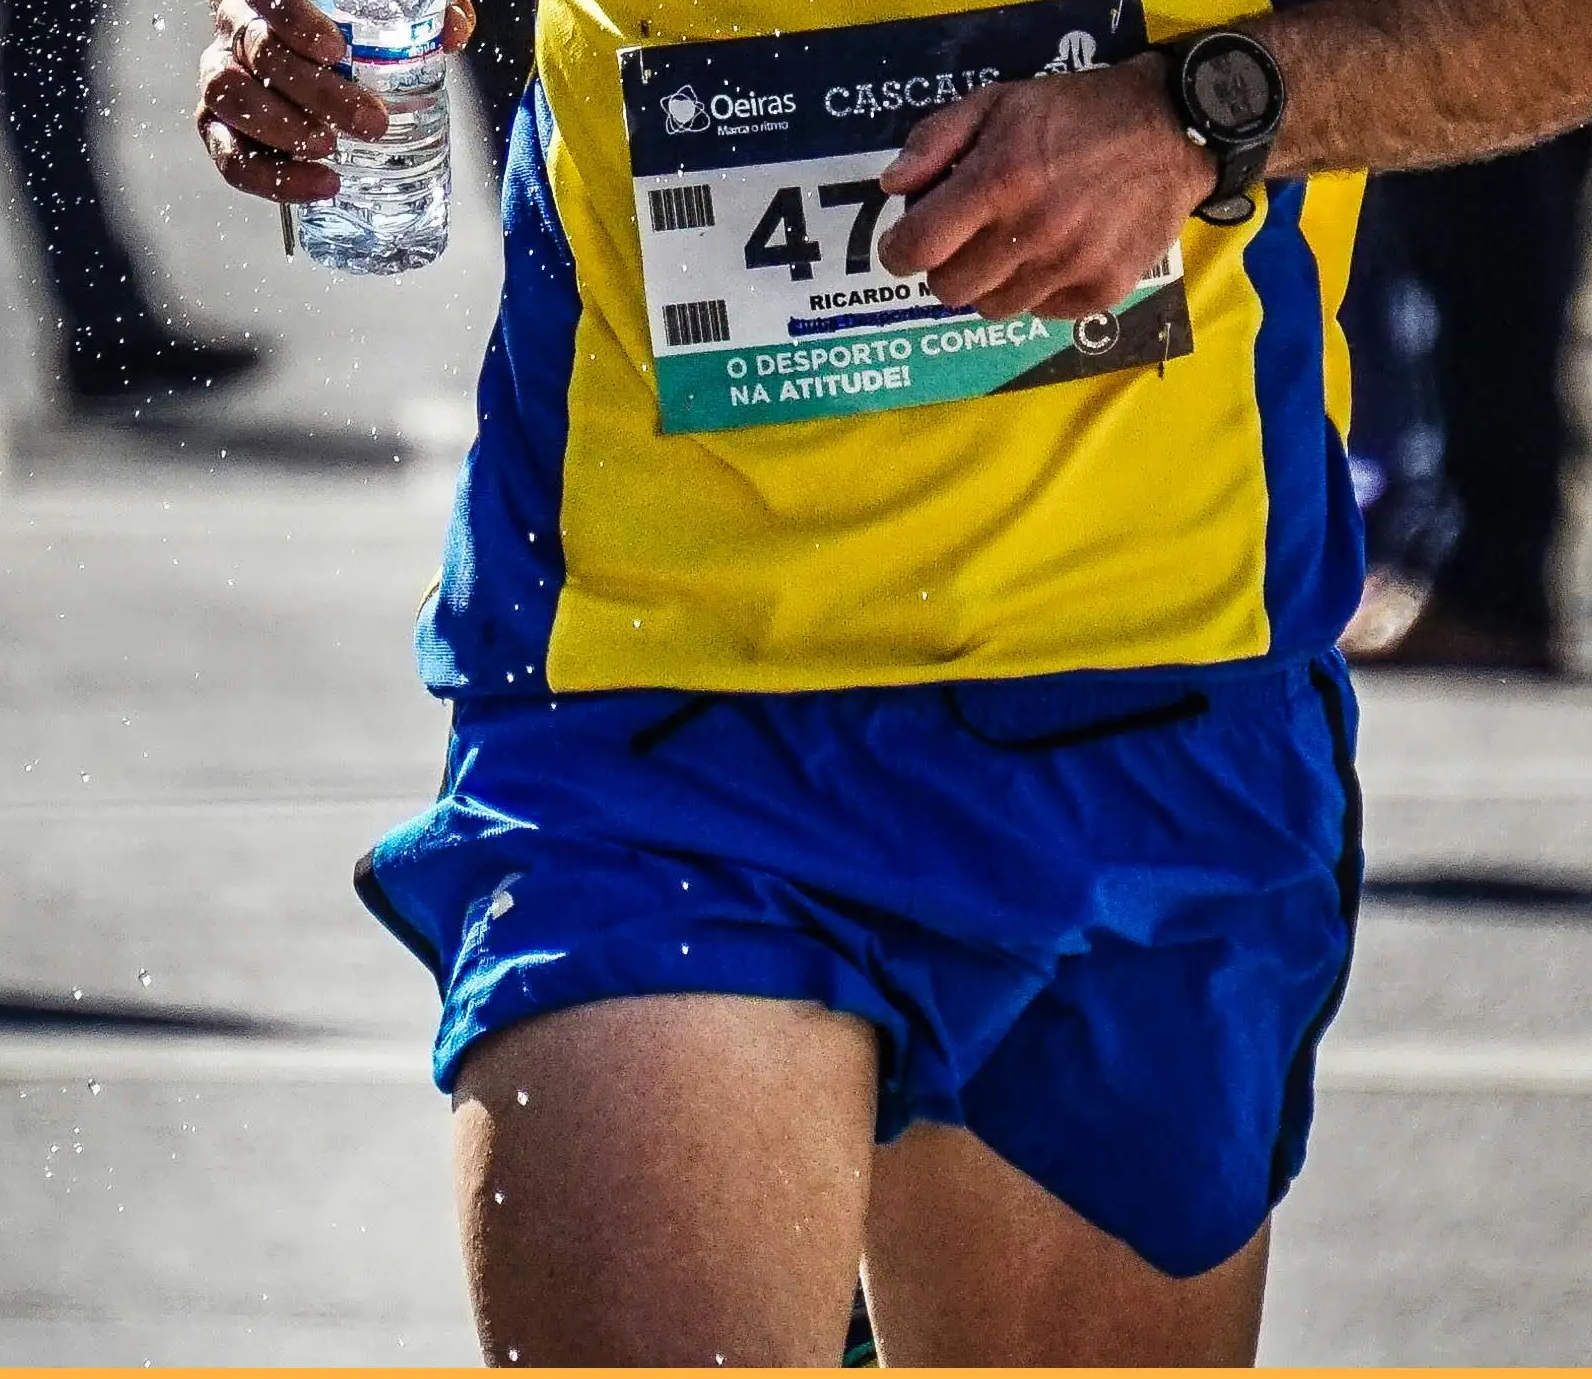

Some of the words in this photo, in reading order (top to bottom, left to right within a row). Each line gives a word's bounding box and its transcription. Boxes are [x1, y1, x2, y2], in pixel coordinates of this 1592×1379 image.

[710, 90, 797, 120] Oeiras
[810, 284, 911, 311] RICARDO
[726, 357, 748, 379] O
[756, 336, 912, 377] DESPORTO
[920, 318, 1051, 356] COMEÇA
[730, 381, 771, 407] NA
[779, 364, 910, 403] ATITUDE!
